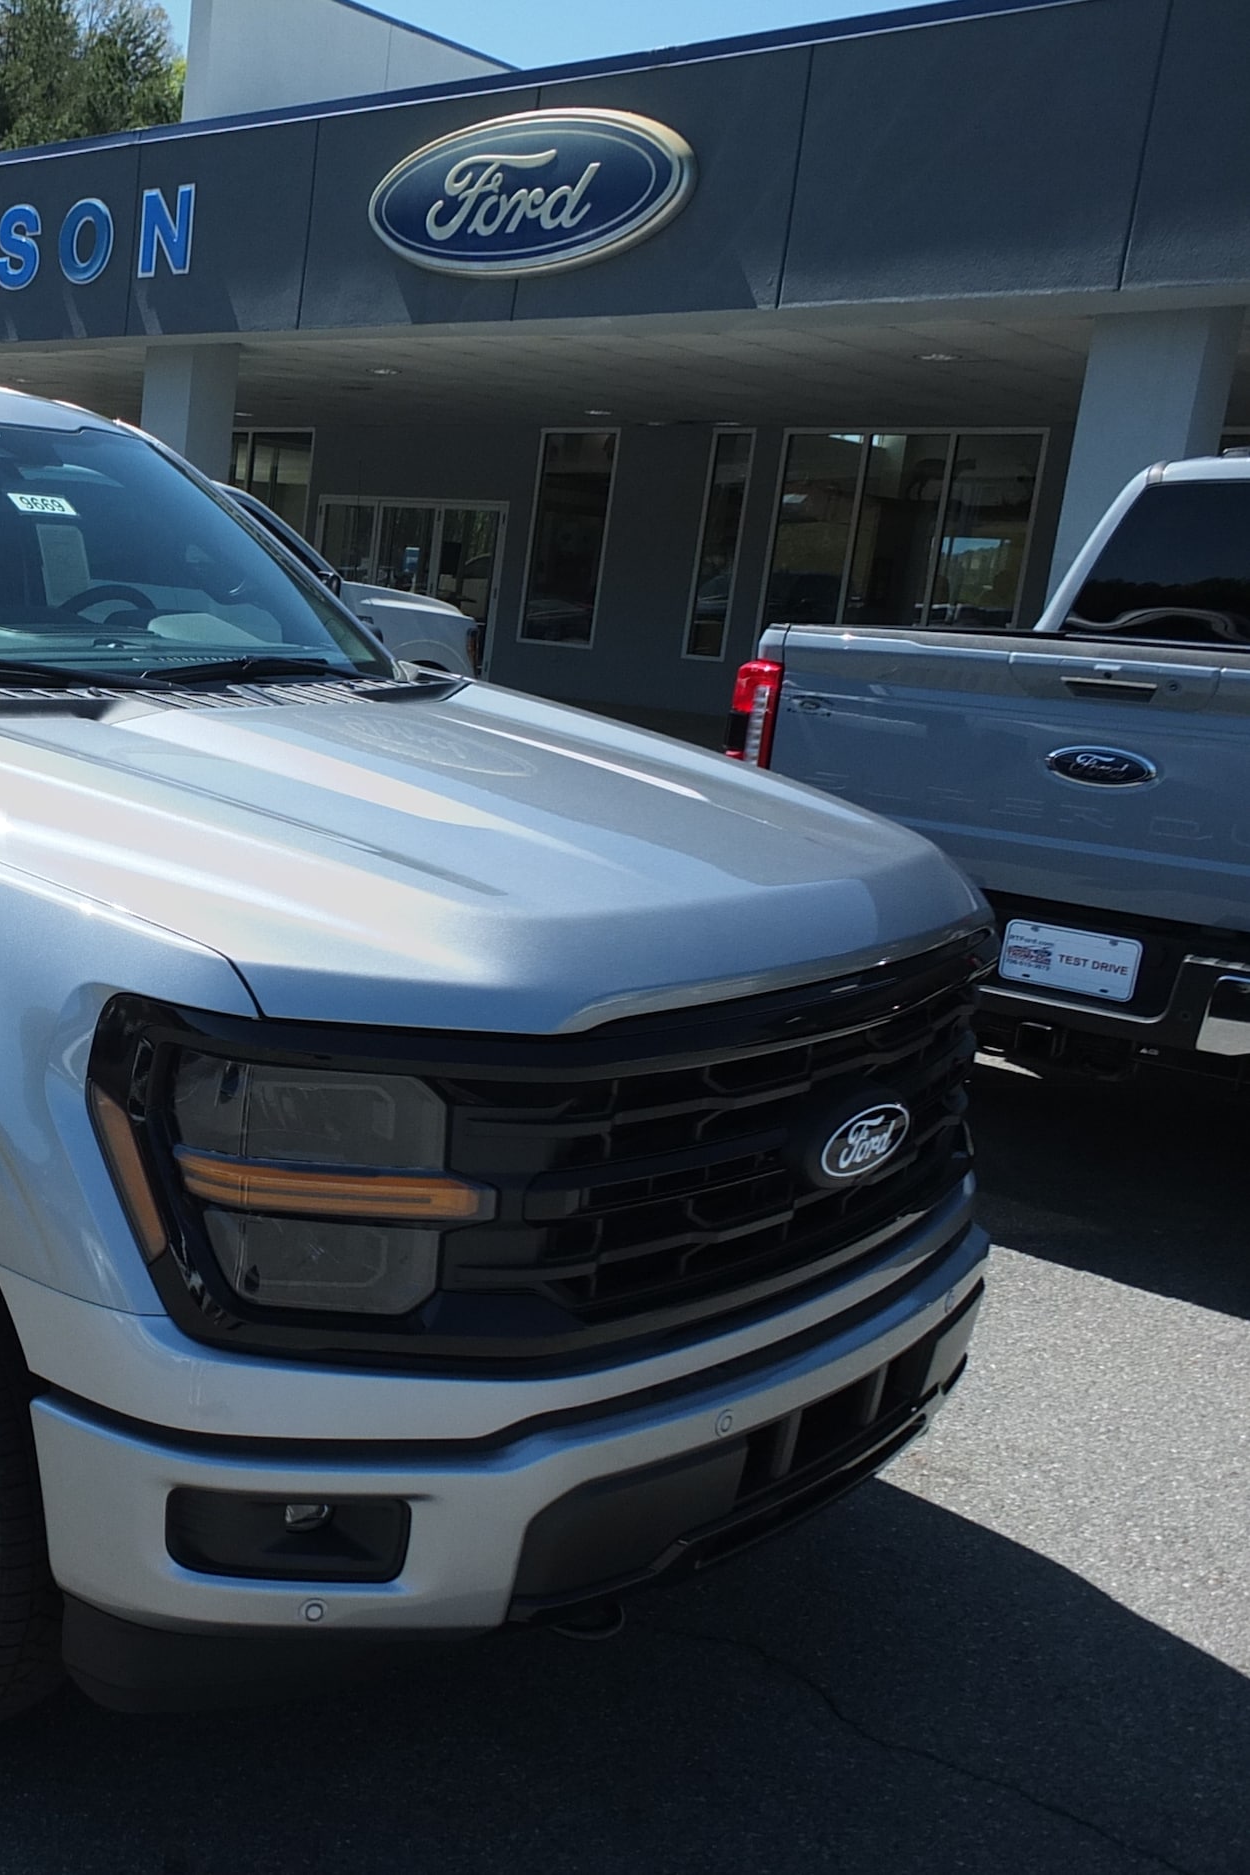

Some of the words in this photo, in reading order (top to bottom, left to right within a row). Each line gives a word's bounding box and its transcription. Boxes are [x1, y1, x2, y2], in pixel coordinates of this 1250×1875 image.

[425, 148, 602, 241] Ford
[18, 496, 66, 513] 9669
[1069, 753, 1129, 778] Ford
[1057, 953, 1089, 967] TEST
[1091, 960, 1130, 976] DRIVE
[838, 1114, 896, 1169] Ford
